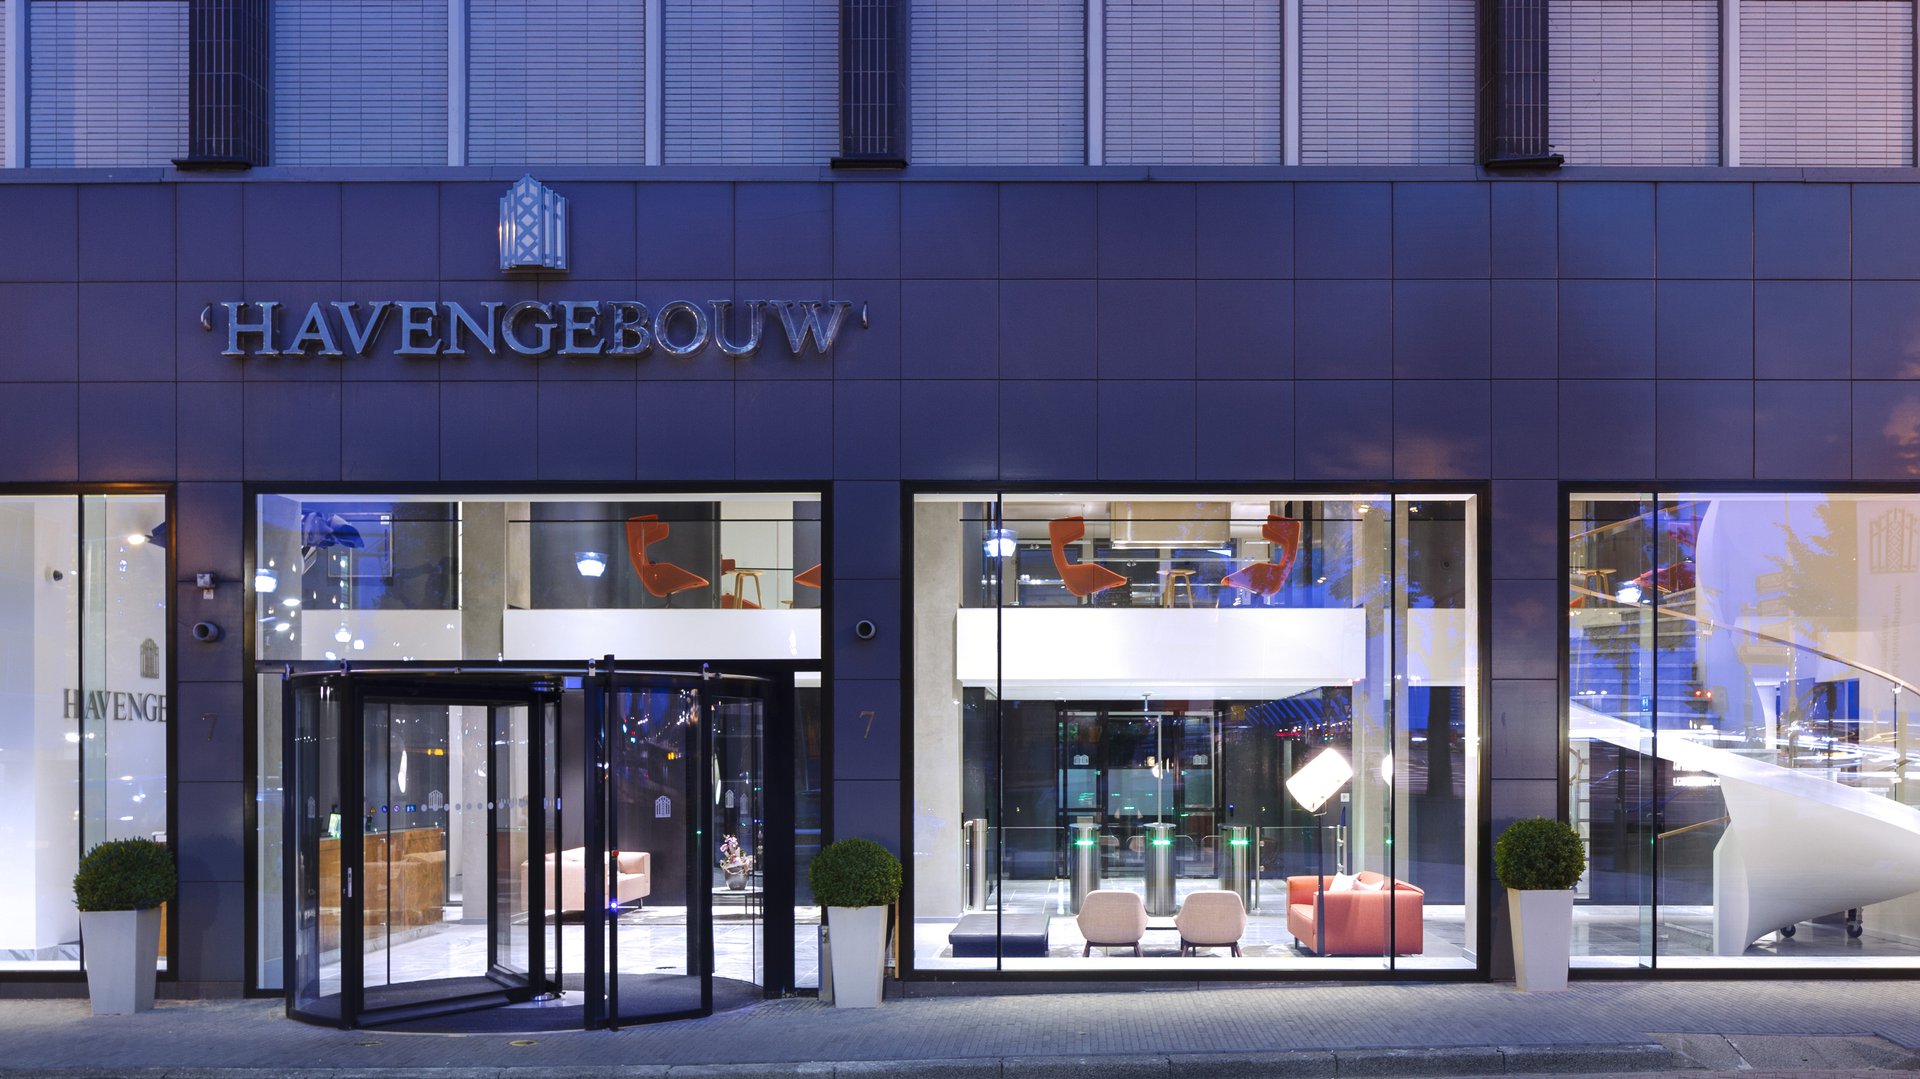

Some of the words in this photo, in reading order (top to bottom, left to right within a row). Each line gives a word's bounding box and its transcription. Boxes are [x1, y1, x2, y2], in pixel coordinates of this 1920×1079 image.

[220, 300, 853, 356] HAVENGEBOUW
[202, 712, 219, 741] 7
[859, 710, 876, 739] 7
